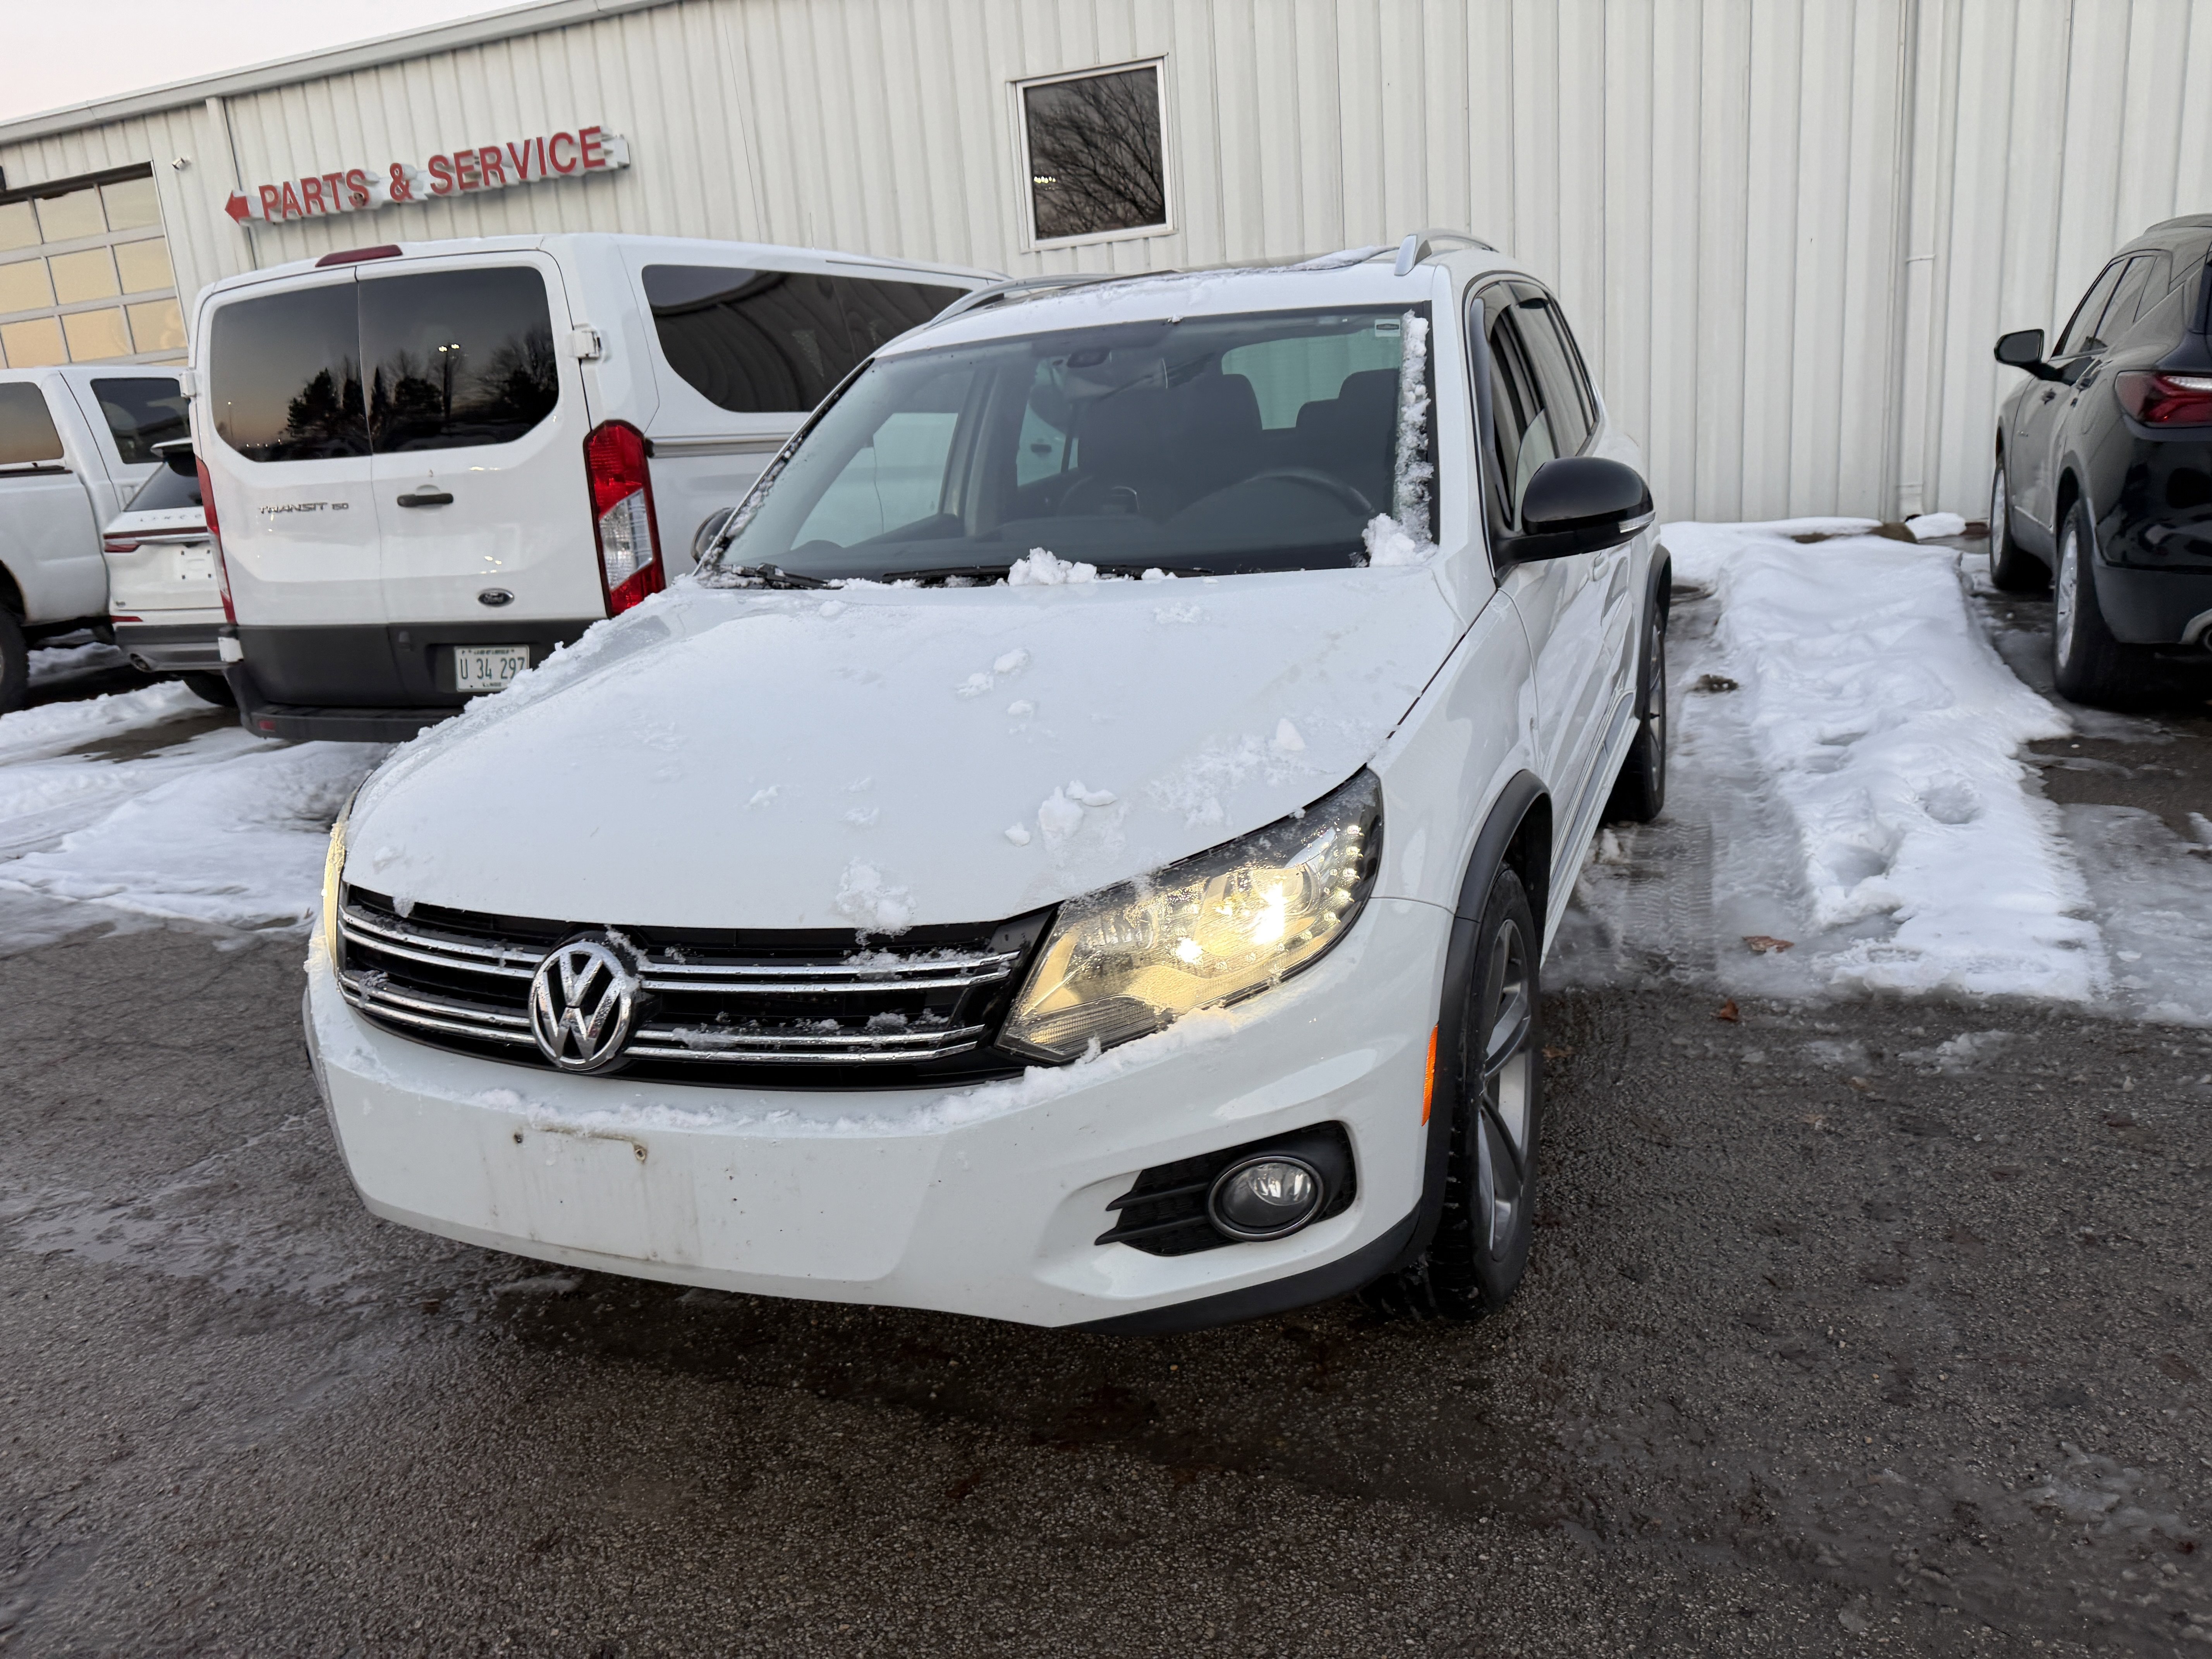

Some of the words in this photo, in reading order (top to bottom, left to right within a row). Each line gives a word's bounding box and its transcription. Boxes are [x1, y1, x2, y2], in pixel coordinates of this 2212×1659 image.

[258, 168, 369, 222] PARTS
[389, 162, 413, 201] &
[427, 125, 607, 195] SERVICE
[259, 502, 328, 514] TRANSIT
[460, 658, 468, 680] U
[476, 658, 492, 679] 34
[500, 657, 525, 679] 297
[533, 947, 625, 1066] VW
